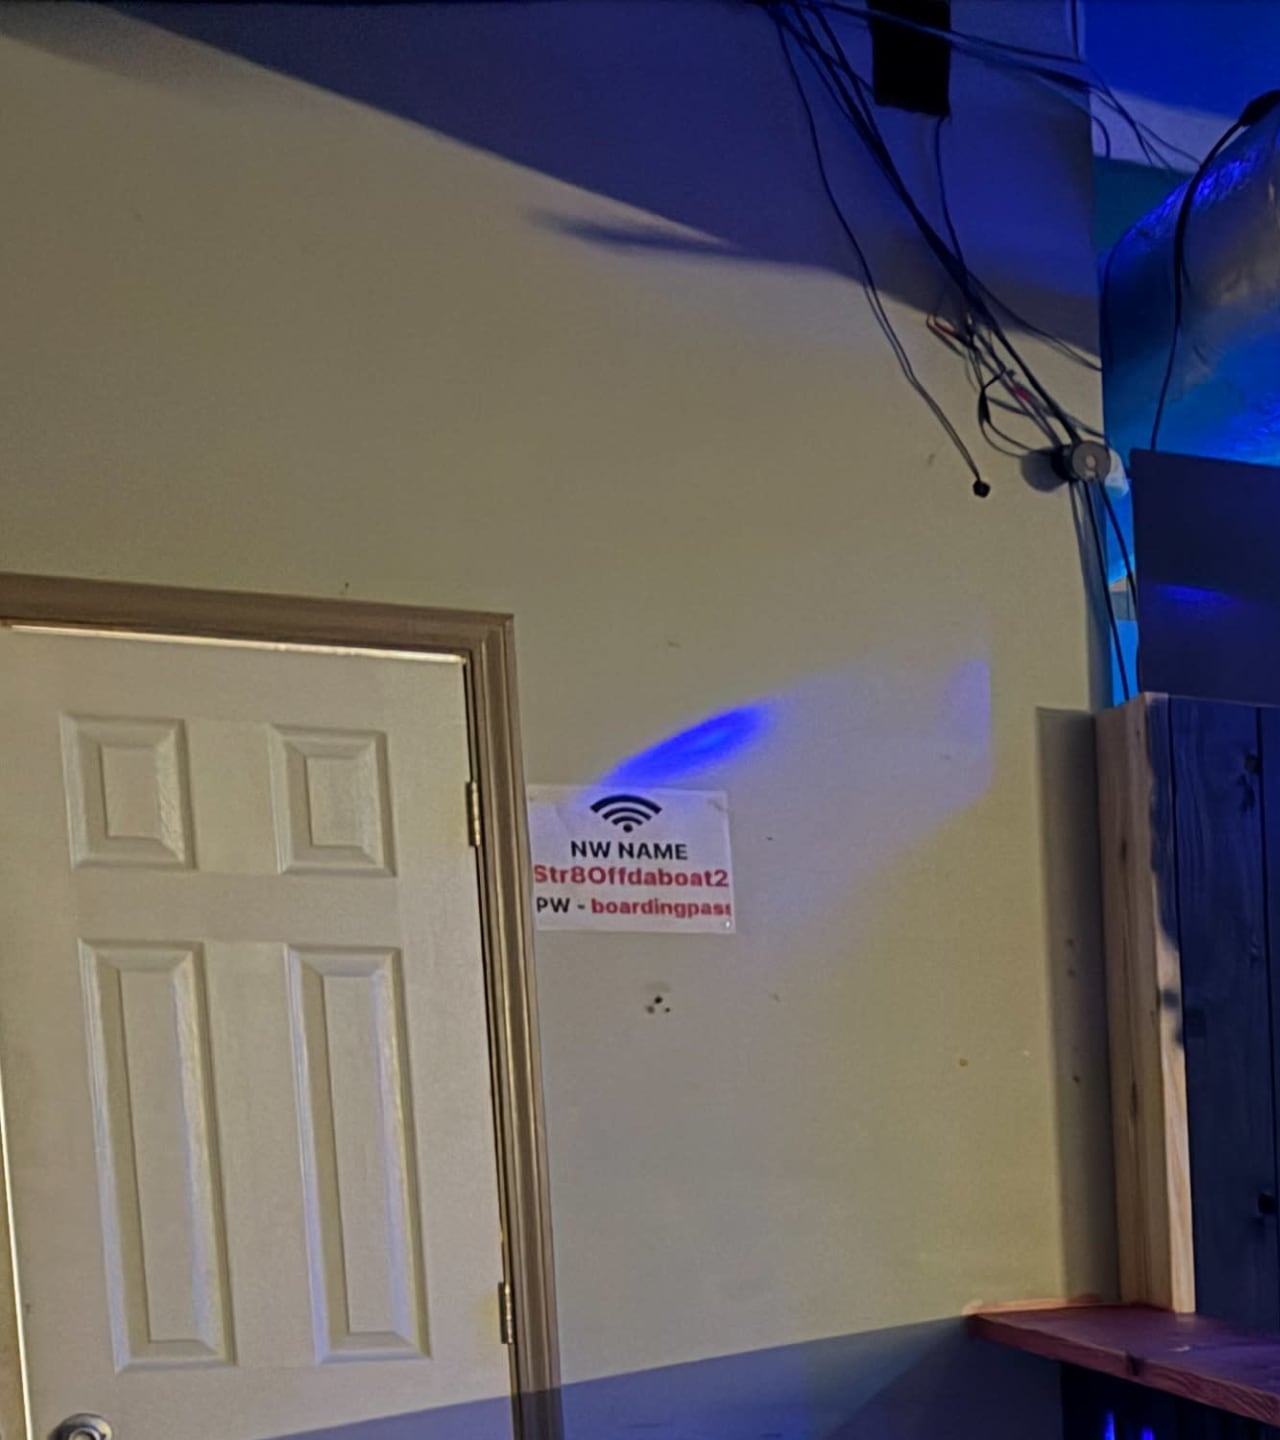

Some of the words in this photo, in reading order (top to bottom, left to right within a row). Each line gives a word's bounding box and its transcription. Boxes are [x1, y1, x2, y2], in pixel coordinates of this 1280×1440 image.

[571, 840, 611, 858] NW
[618, 841, 688, 860] NAME
[536, 897, 570, 913] PW
